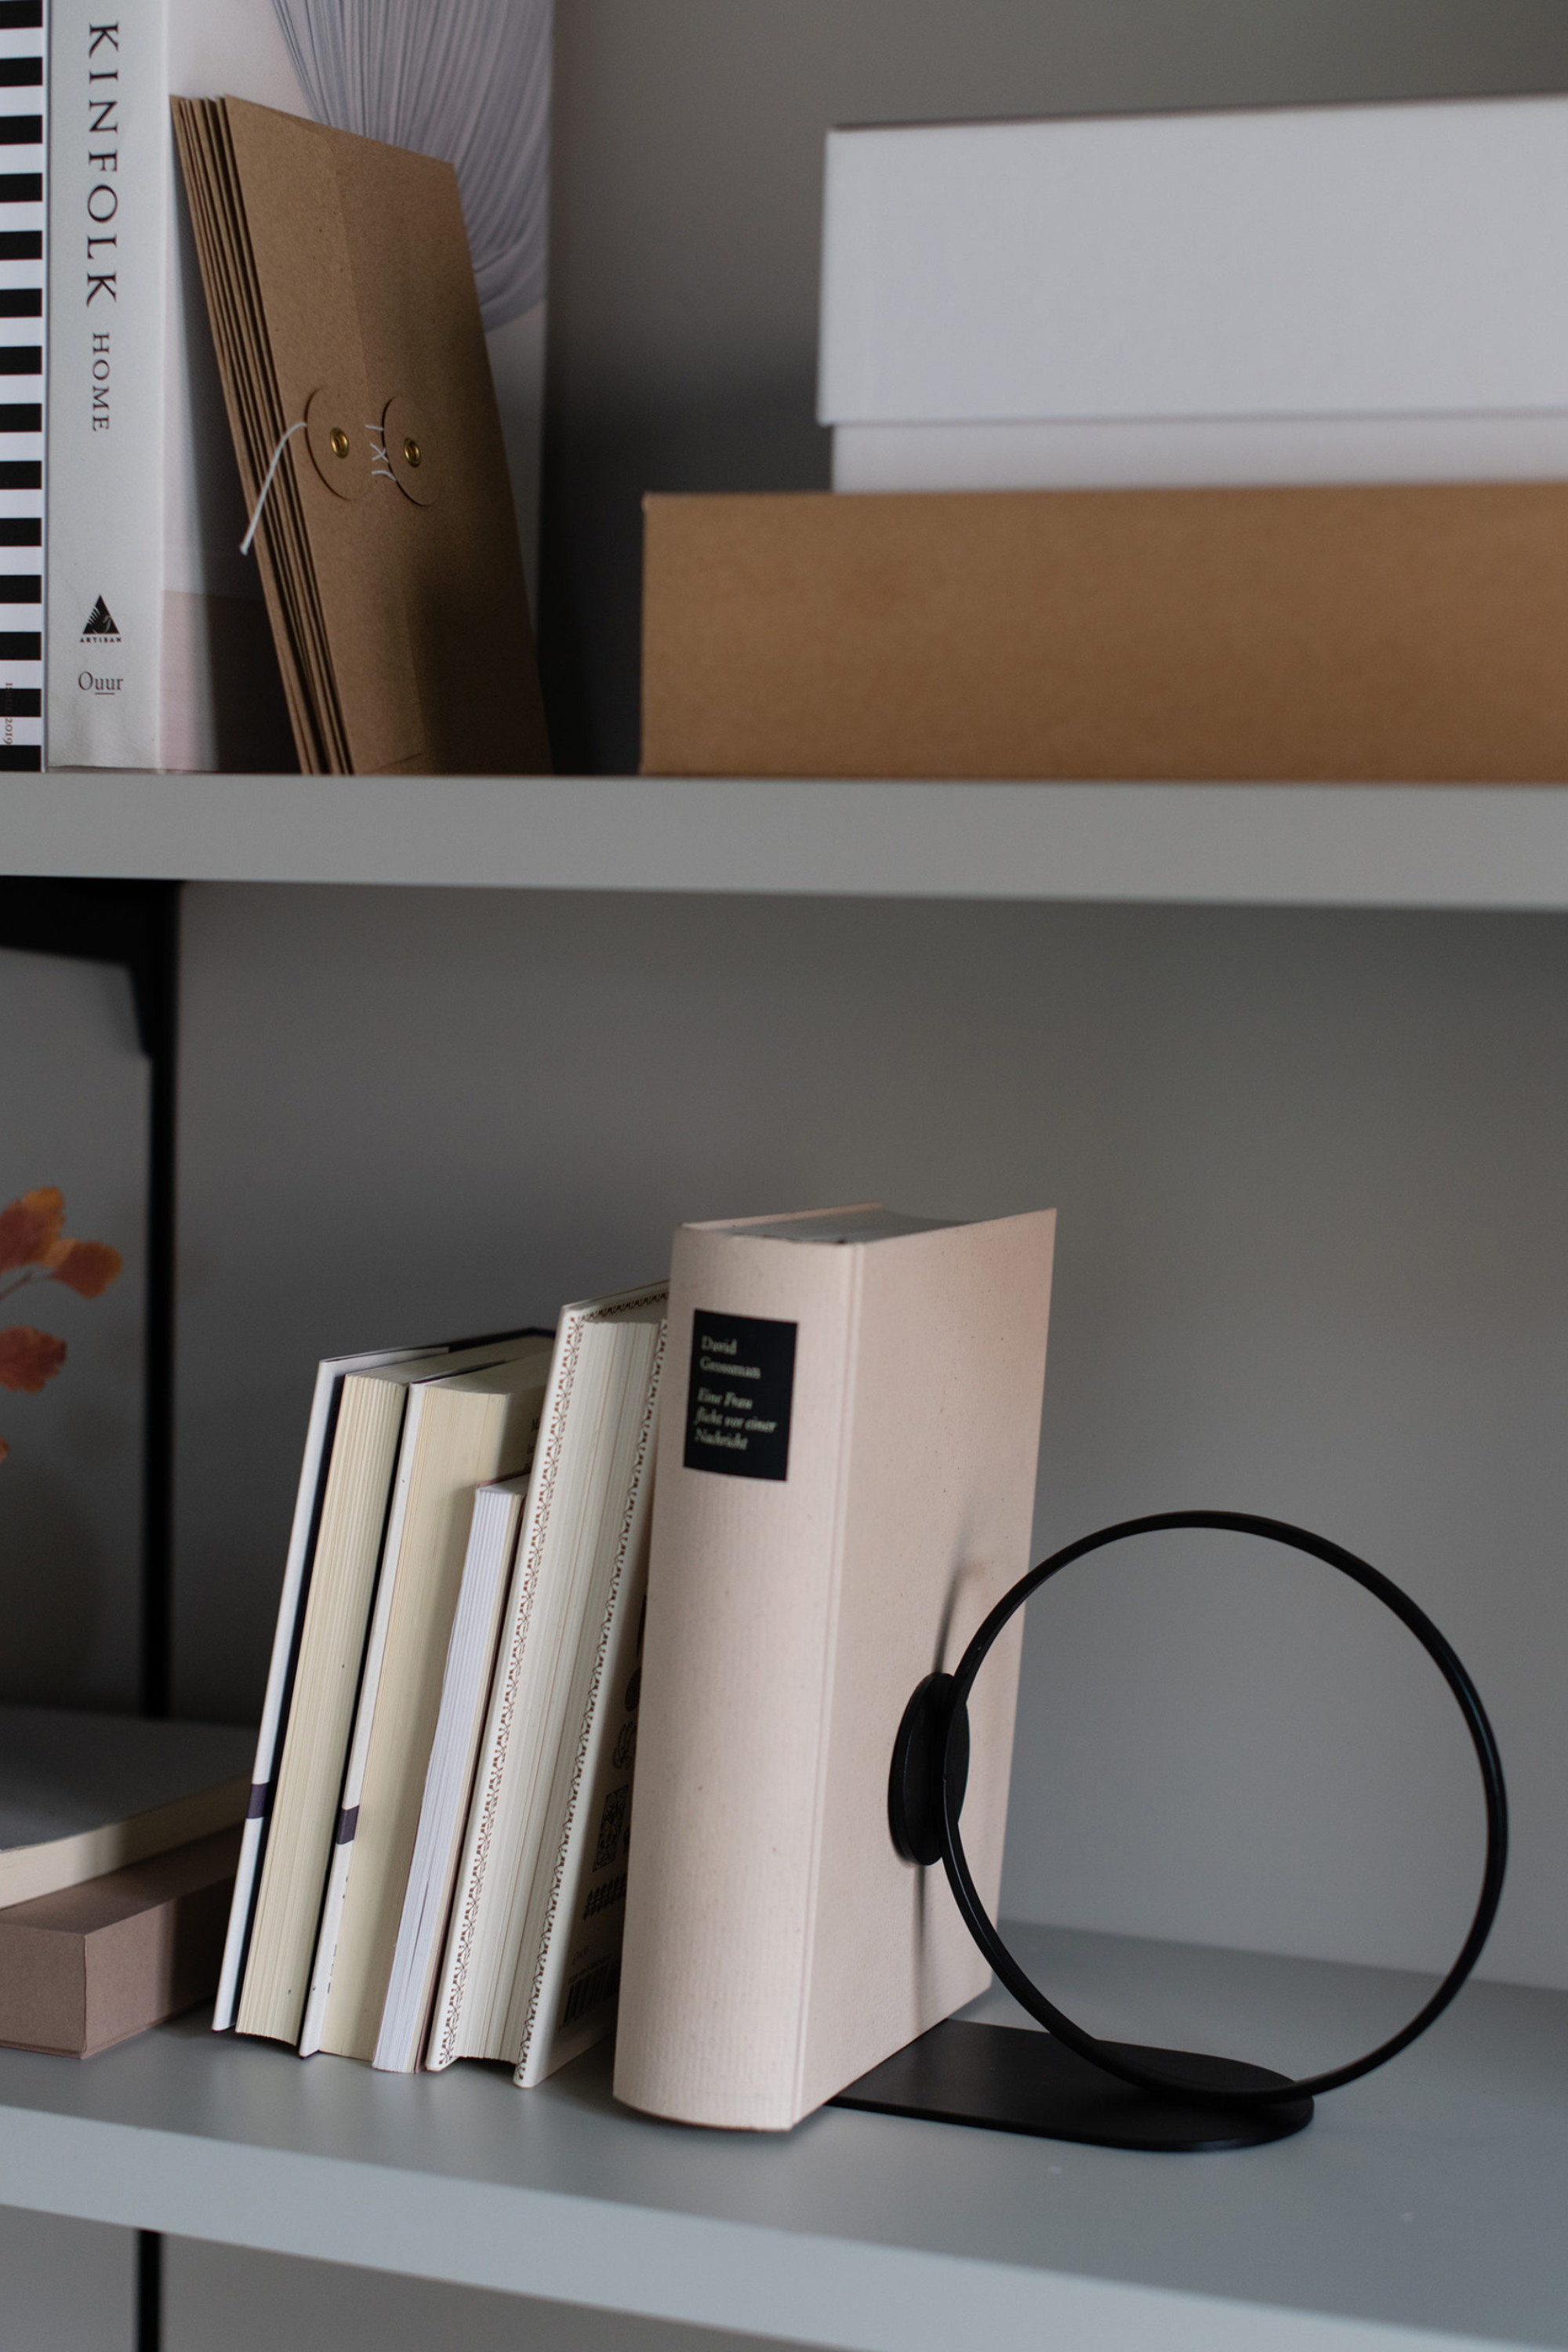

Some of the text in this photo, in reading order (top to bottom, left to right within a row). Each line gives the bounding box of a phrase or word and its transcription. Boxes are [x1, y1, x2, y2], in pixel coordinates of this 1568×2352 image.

[86, 21, 118, 432] KINFOLK HOME
[78, 671, 123, 691] Ouur
[3, 717, 13, 745] 2019
[701, 1335, 738, 1356] David
